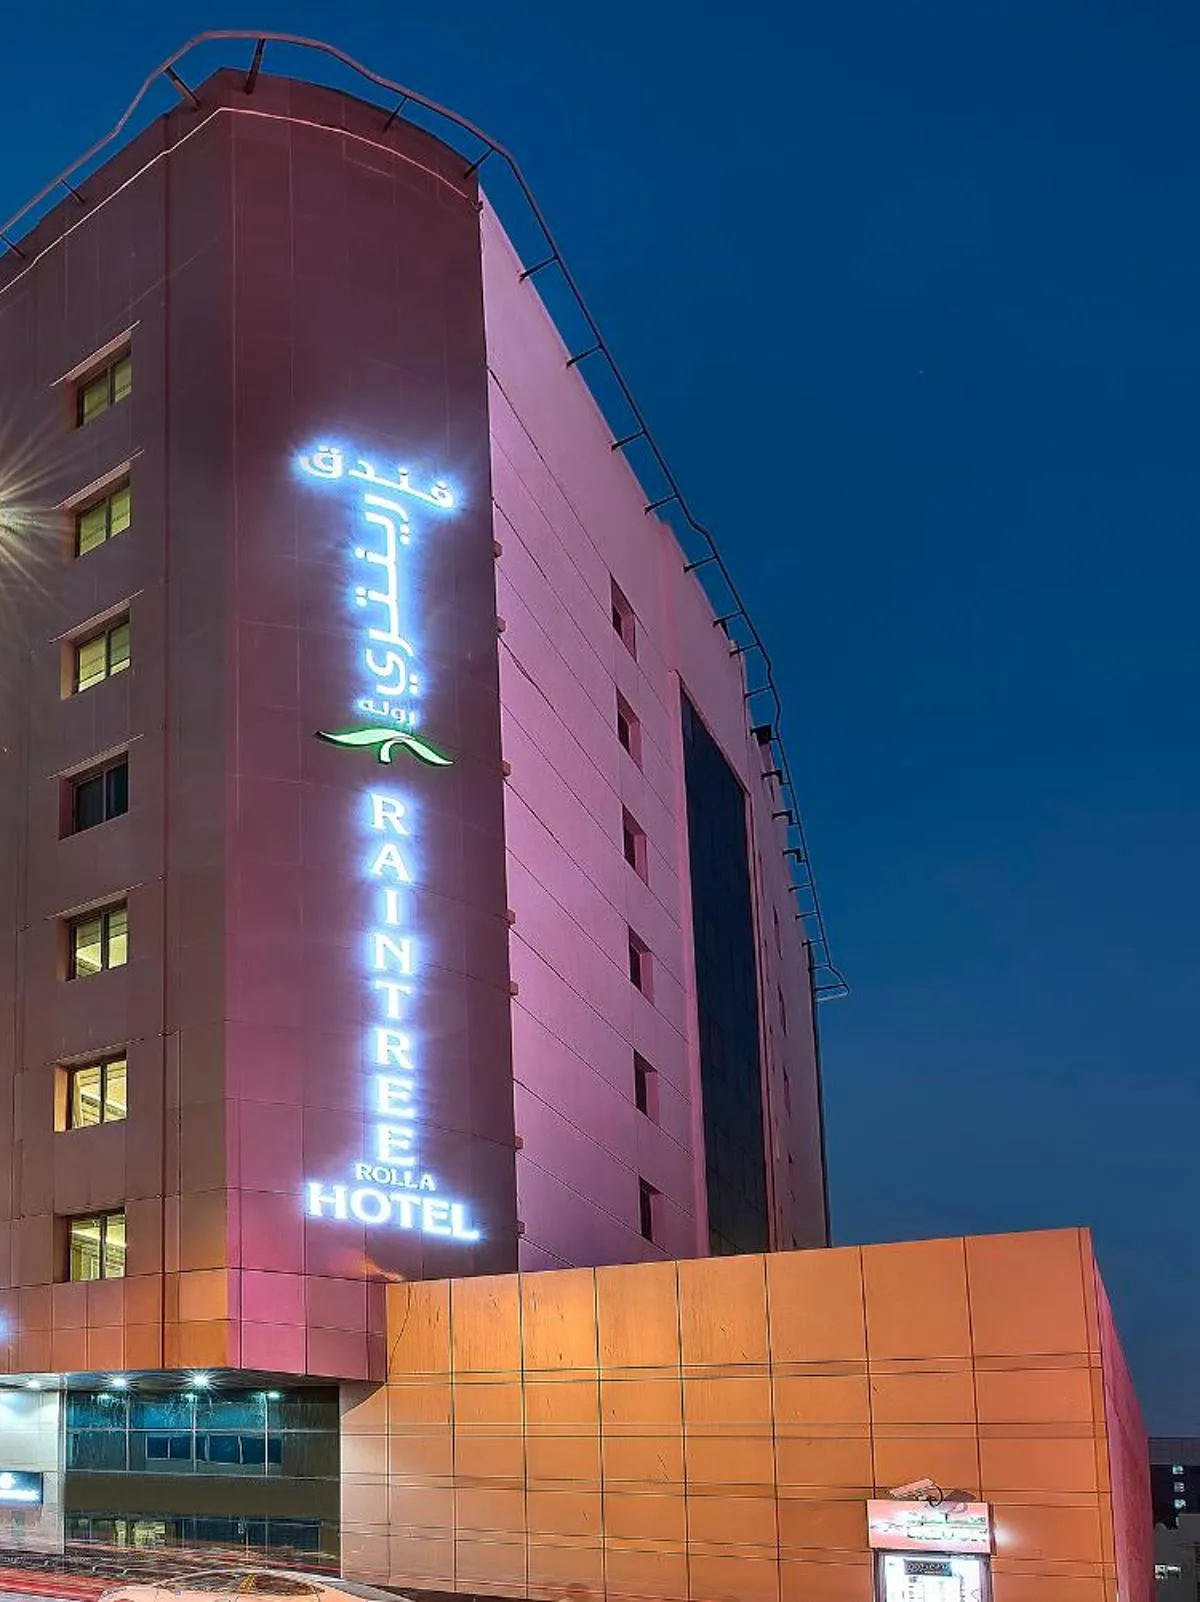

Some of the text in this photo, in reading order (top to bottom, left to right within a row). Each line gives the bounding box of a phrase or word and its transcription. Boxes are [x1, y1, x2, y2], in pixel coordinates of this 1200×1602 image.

[301, 446, 455, 508] فندق
[356, 493, 421, 697] رينتري
[371, 793, 416, 1167] RAINTREE
[356, 1164, 438, 1192] ROLLA
[304, 1181, 481, 1240] HOTEL
